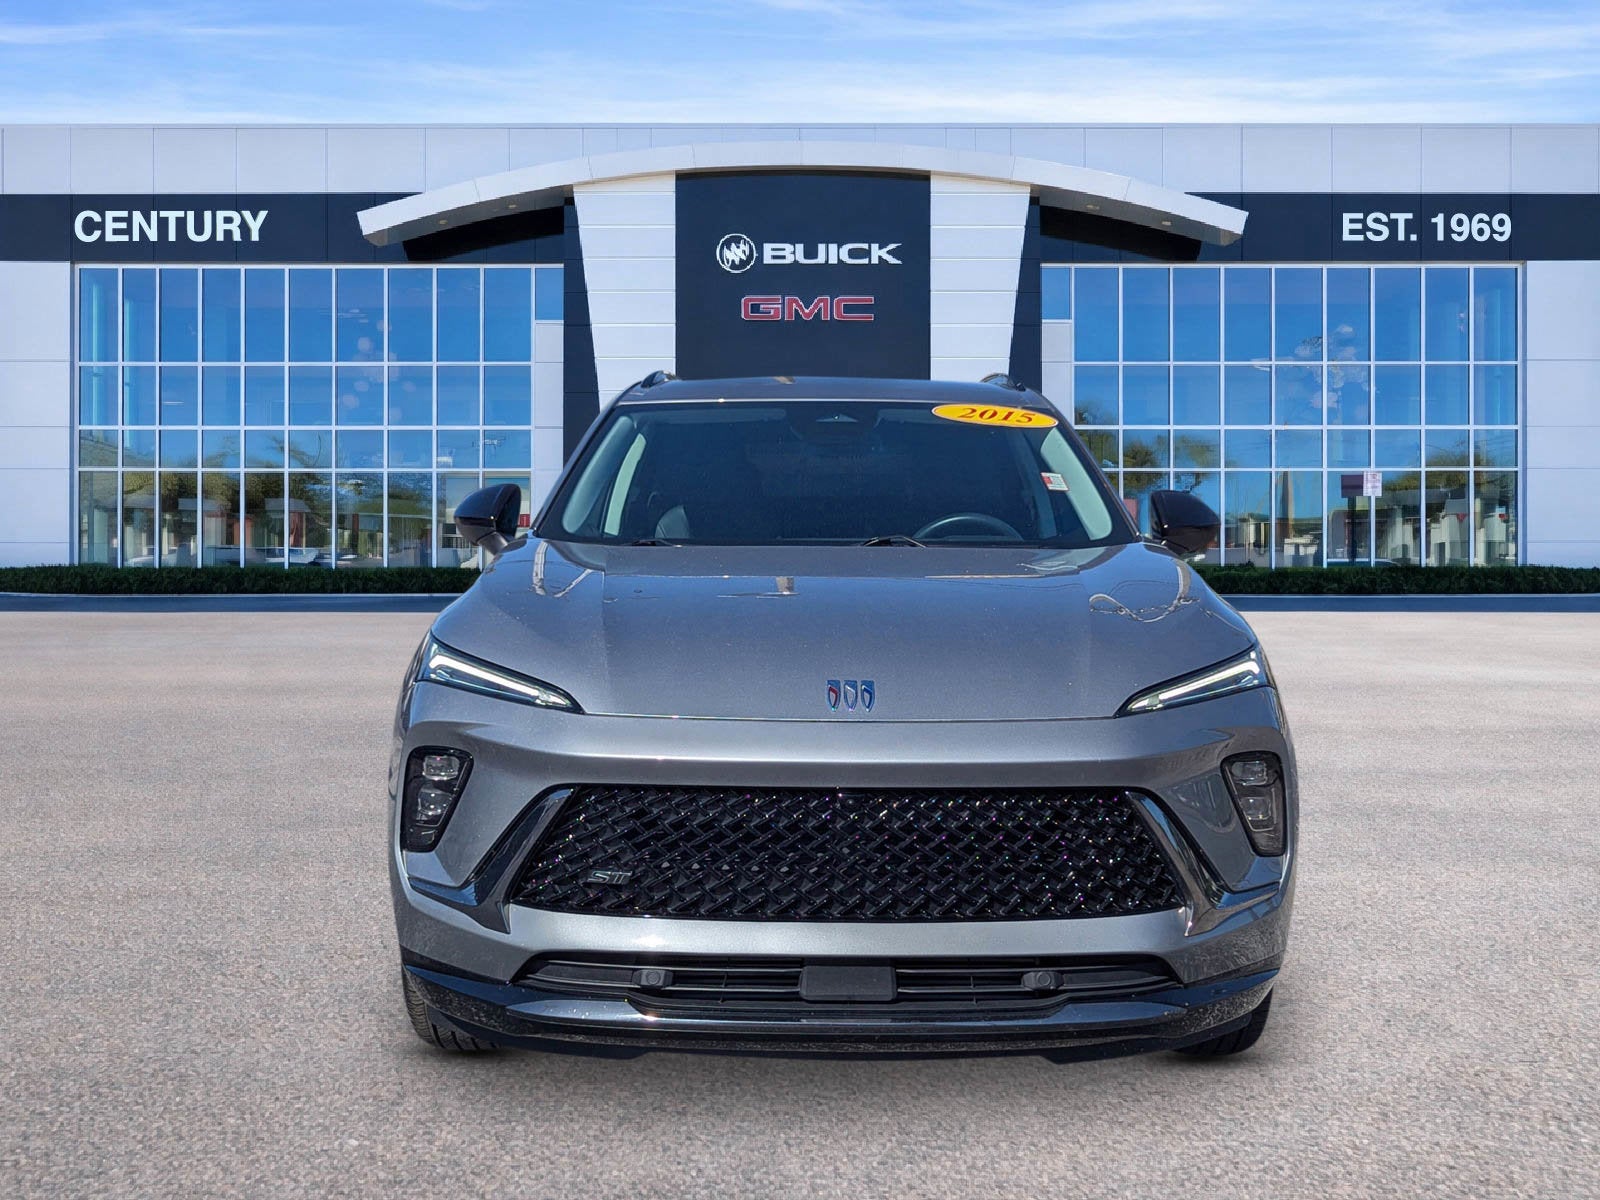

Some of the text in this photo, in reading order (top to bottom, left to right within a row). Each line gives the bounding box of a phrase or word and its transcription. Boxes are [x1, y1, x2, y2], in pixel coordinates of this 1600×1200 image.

[74, 210, 268, 243] CENTURY
[1342, 212, 1512, 242] EST. 1969
[762, 242, 903, 265] BUICK
[741, 295, 875, 321] GMC
[957, 407, 1036, 424] 2015
[587, 870, 633, 884] ST
